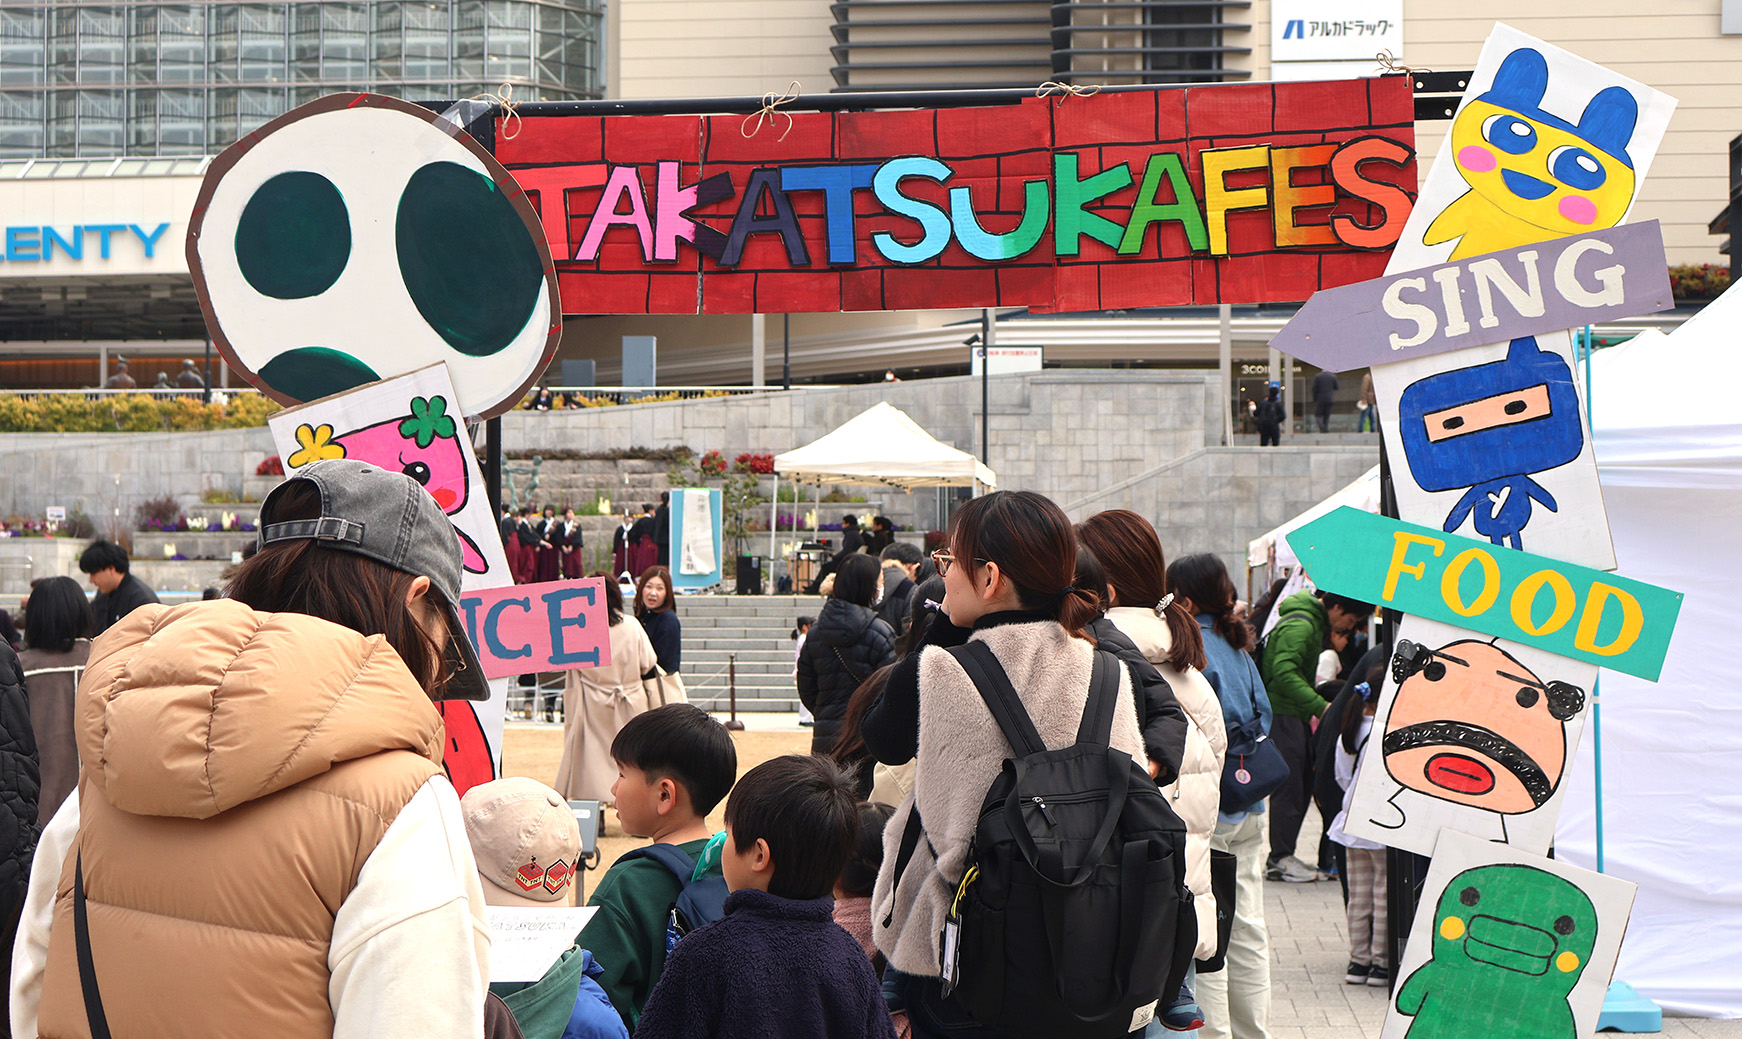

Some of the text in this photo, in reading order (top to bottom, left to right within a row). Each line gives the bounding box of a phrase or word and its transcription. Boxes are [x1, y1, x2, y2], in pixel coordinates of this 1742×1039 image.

[1309, 20, 1394, 36] アルカドラッグ
[0, 222, 171, 261] ENTY
[507, 134, 1417, 270] TAKATSUKAFES
[1382, 238, 1626, 351] SING
[1381, 530, 1645, 657] FOOD
